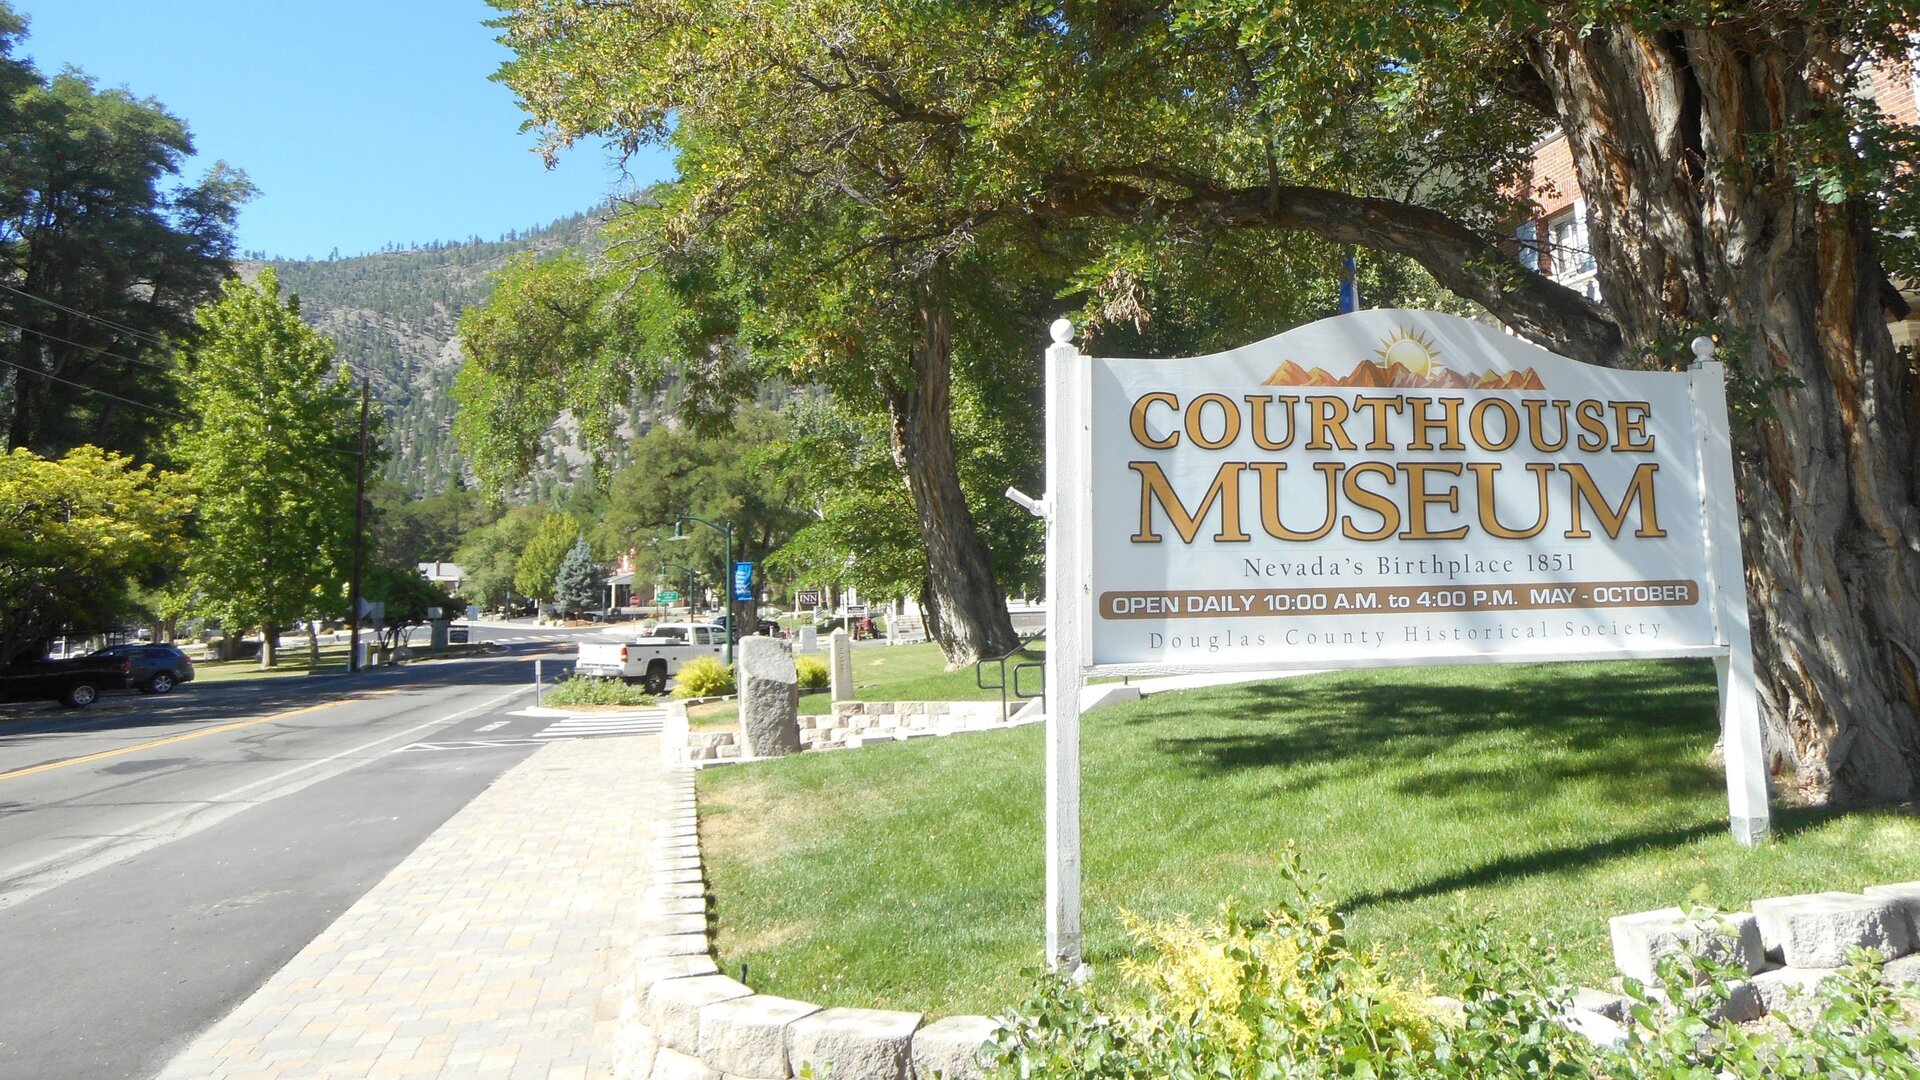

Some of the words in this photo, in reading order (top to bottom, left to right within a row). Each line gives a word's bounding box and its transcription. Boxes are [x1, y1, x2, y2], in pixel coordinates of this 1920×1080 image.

[1129, 391, 1655, 453] COURTHOUSE
[1128, 461, 1667, 545] MUSEUM
[1243, 556, 1364, 577] Nevada's
[1377, 554, 1514, 580] Birthplace
[1527, 553, 1575, 573] 1851
[800, 594, 817, 602] INN
[1112, 596, 1179, 615] OPEN
[1187, 595, 1255, 613] DAILY
[1263, 593, 1327, 611] 10:00
[1333, 592, 1382, 609] A.M.
[1387, 594, 1410, 608] to
[1416, 590, 1466, 608] 4:00
[1473, 590, 1518, 606] P.M.
[1530, 588, 1576, 605] MAY
[1593, 585, 1689, 603] OCTOBER
[1150, 630, 1266, 652] Douglas
[1285, 629, 1385, 649] County
[1405, 621, 1547, 642] Historical
[1565, 620, 1662, 640] Society
